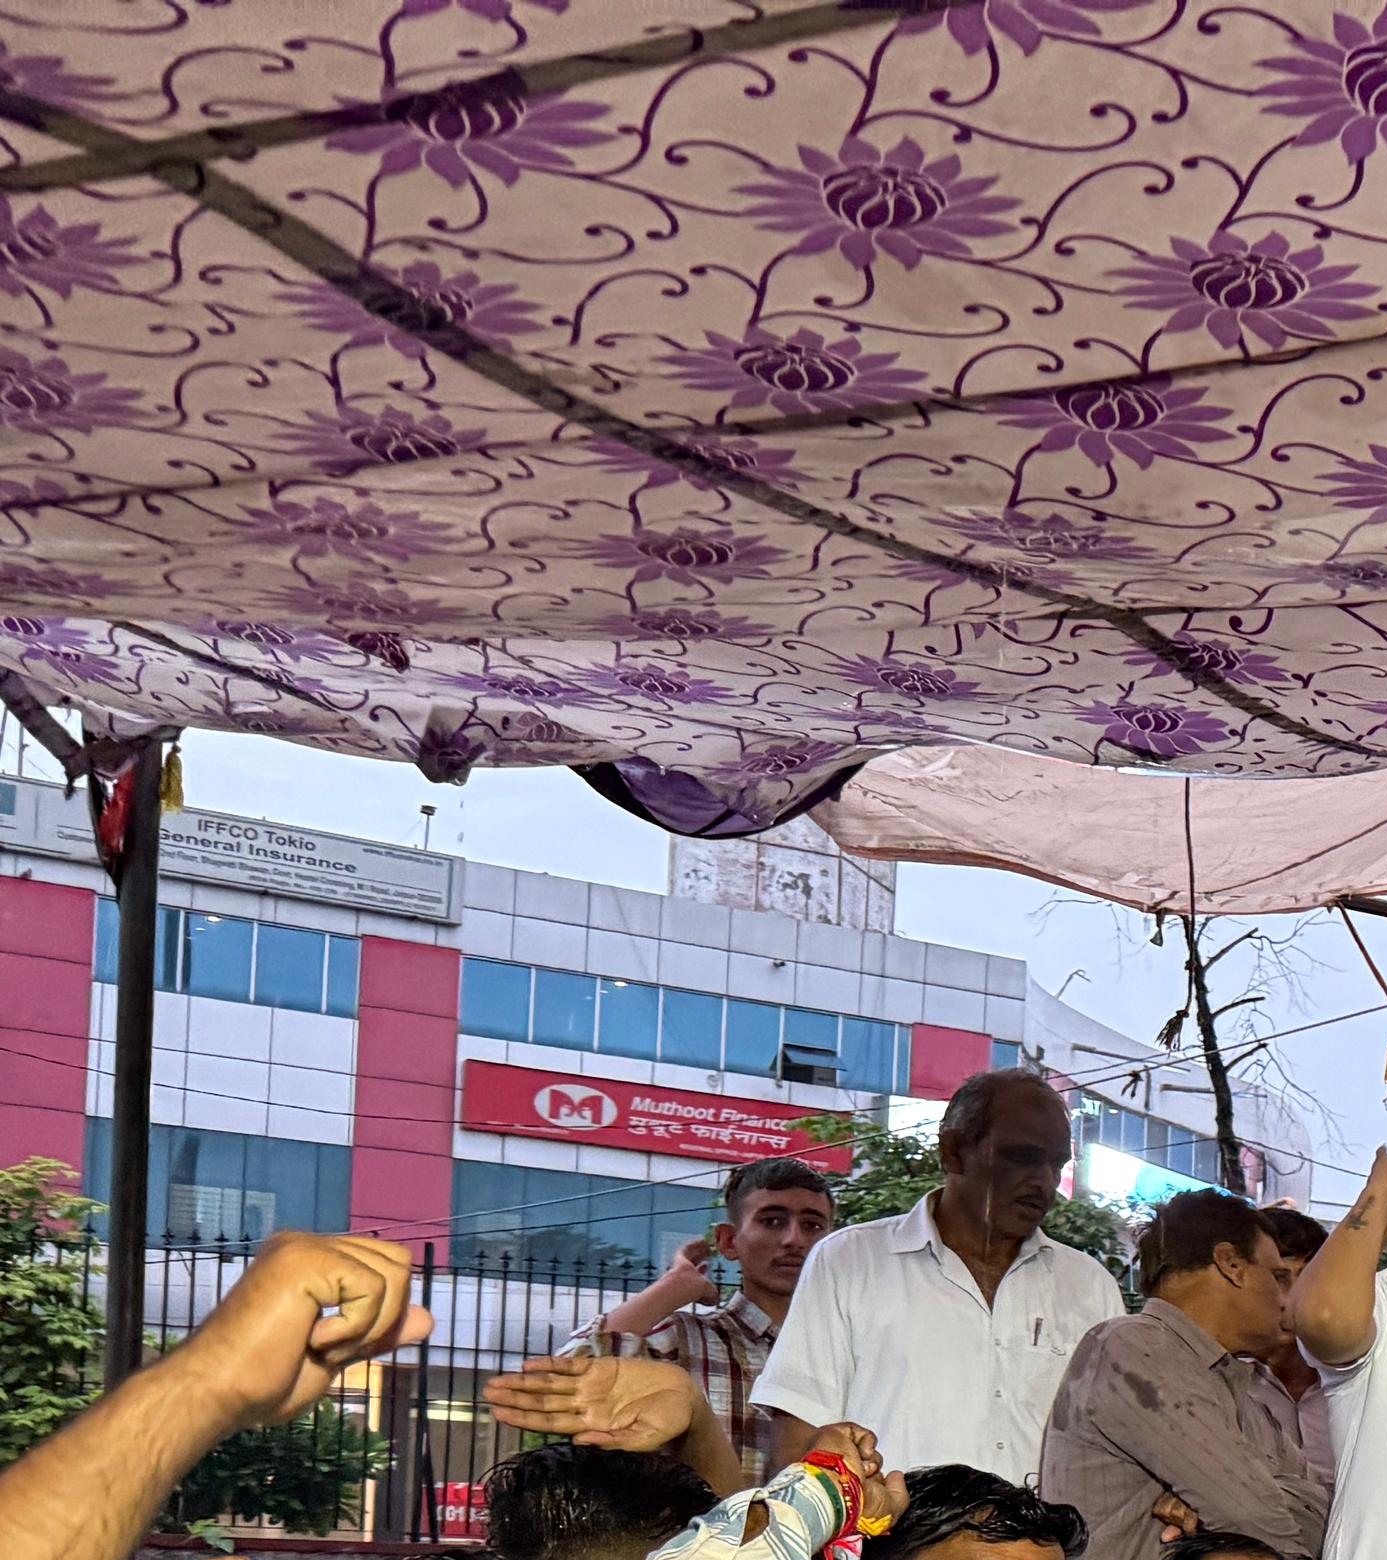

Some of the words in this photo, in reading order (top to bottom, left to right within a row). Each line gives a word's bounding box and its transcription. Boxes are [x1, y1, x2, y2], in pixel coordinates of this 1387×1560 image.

[197, 819, 258, 841] IFFCO
[264, 830, 316, 851] Tokio
[249, 843, 357, 874] Insurance
[630, 1097, 714, 1121] Muthoot
[690, 1124, 791, 1149] फाईनान्स
